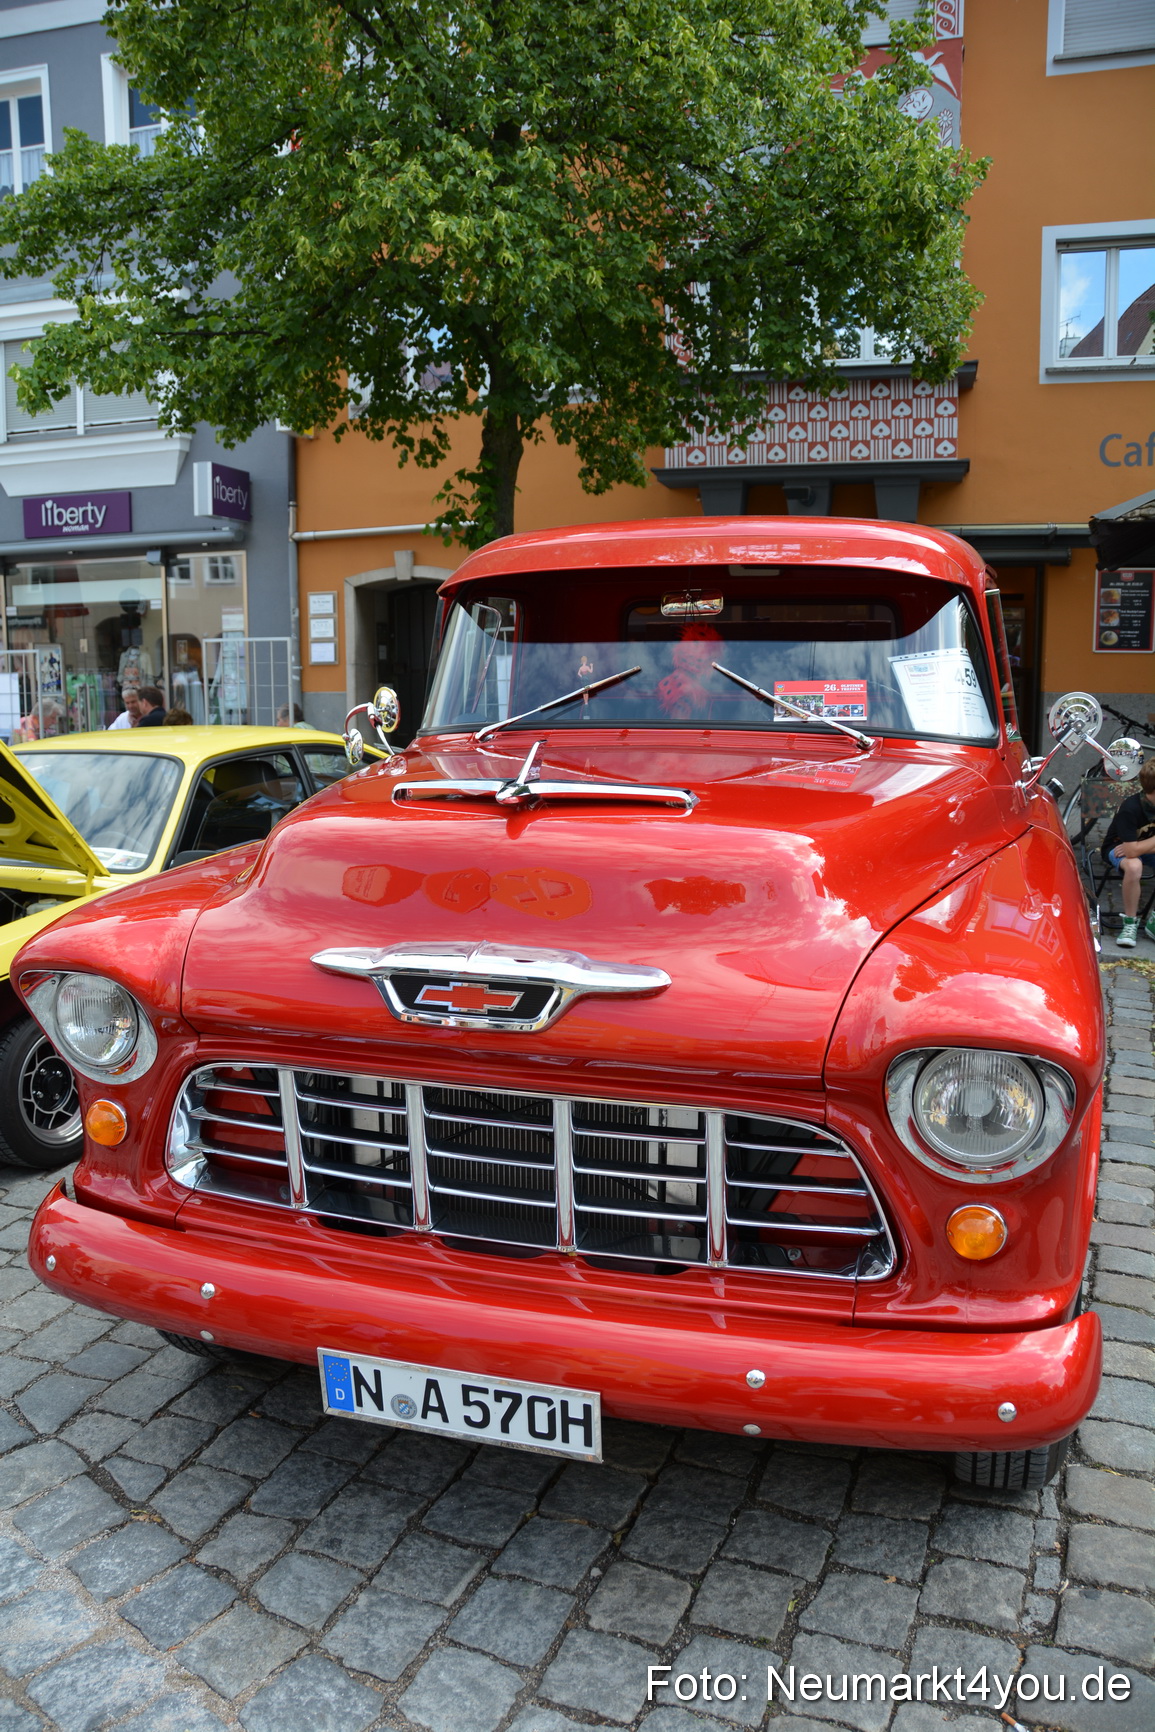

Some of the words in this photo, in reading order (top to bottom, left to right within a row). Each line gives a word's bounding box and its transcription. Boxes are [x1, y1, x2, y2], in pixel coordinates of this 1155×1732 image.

[213, 475, 248, 511] liberty
[41, 499, 107, 529] liberty
[823, 683, 840, 692] 26.
[334, 1387, 346, 1401] D
[352, 1365, 384, 1412] N
